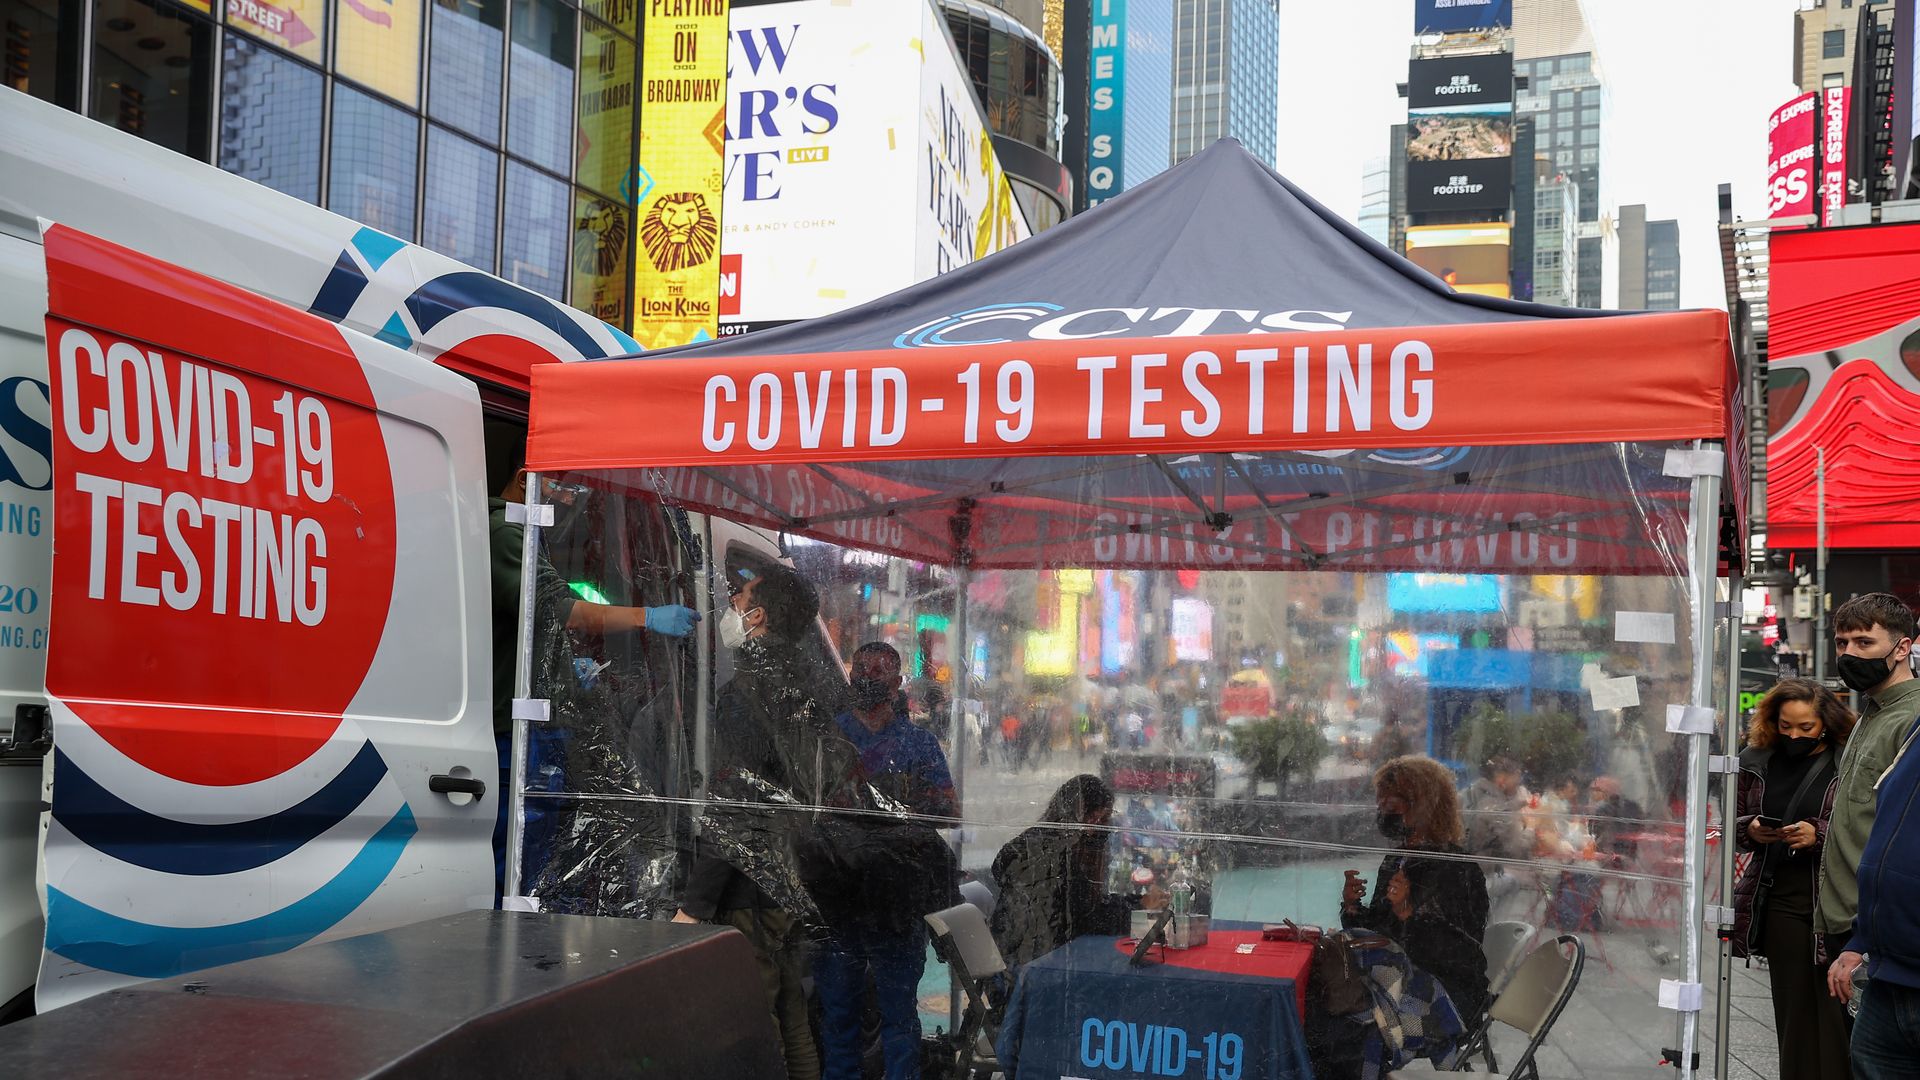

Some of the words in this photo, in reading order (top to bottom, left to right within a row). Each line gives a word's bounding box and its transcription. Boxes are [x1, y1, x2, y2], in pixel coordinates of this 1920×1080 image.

[229, 0, 284, 33] STREET
[652, 0, 724, 17] PLAYING
[674, 31, 697, 63] ON
[727, 24, 801, 79] W
[648, 79, 720, 103] BROADWAY
[1826, 87, 1844, 164] EXPRESS
[793, 148, 824, 162] LIVE
[1433, 183, 1484, 195] FOOTSTEP
[756, 220, 788, 231] ANDY
[793, 218, 836, 229] COHEN
[668, 285, 684, 294] THE
[642, 297, 672, 317] LION
[675, 297, 710, 317] KING
[702, 360, 1035, 452] COVID-19
[1076, 340, 1434, 440] TESTING
[60, 328, 334, 503] COVID-19
[75, 472, 327, 627] TESTING
[1081, 1017, 1244, 1080] COVID-19
